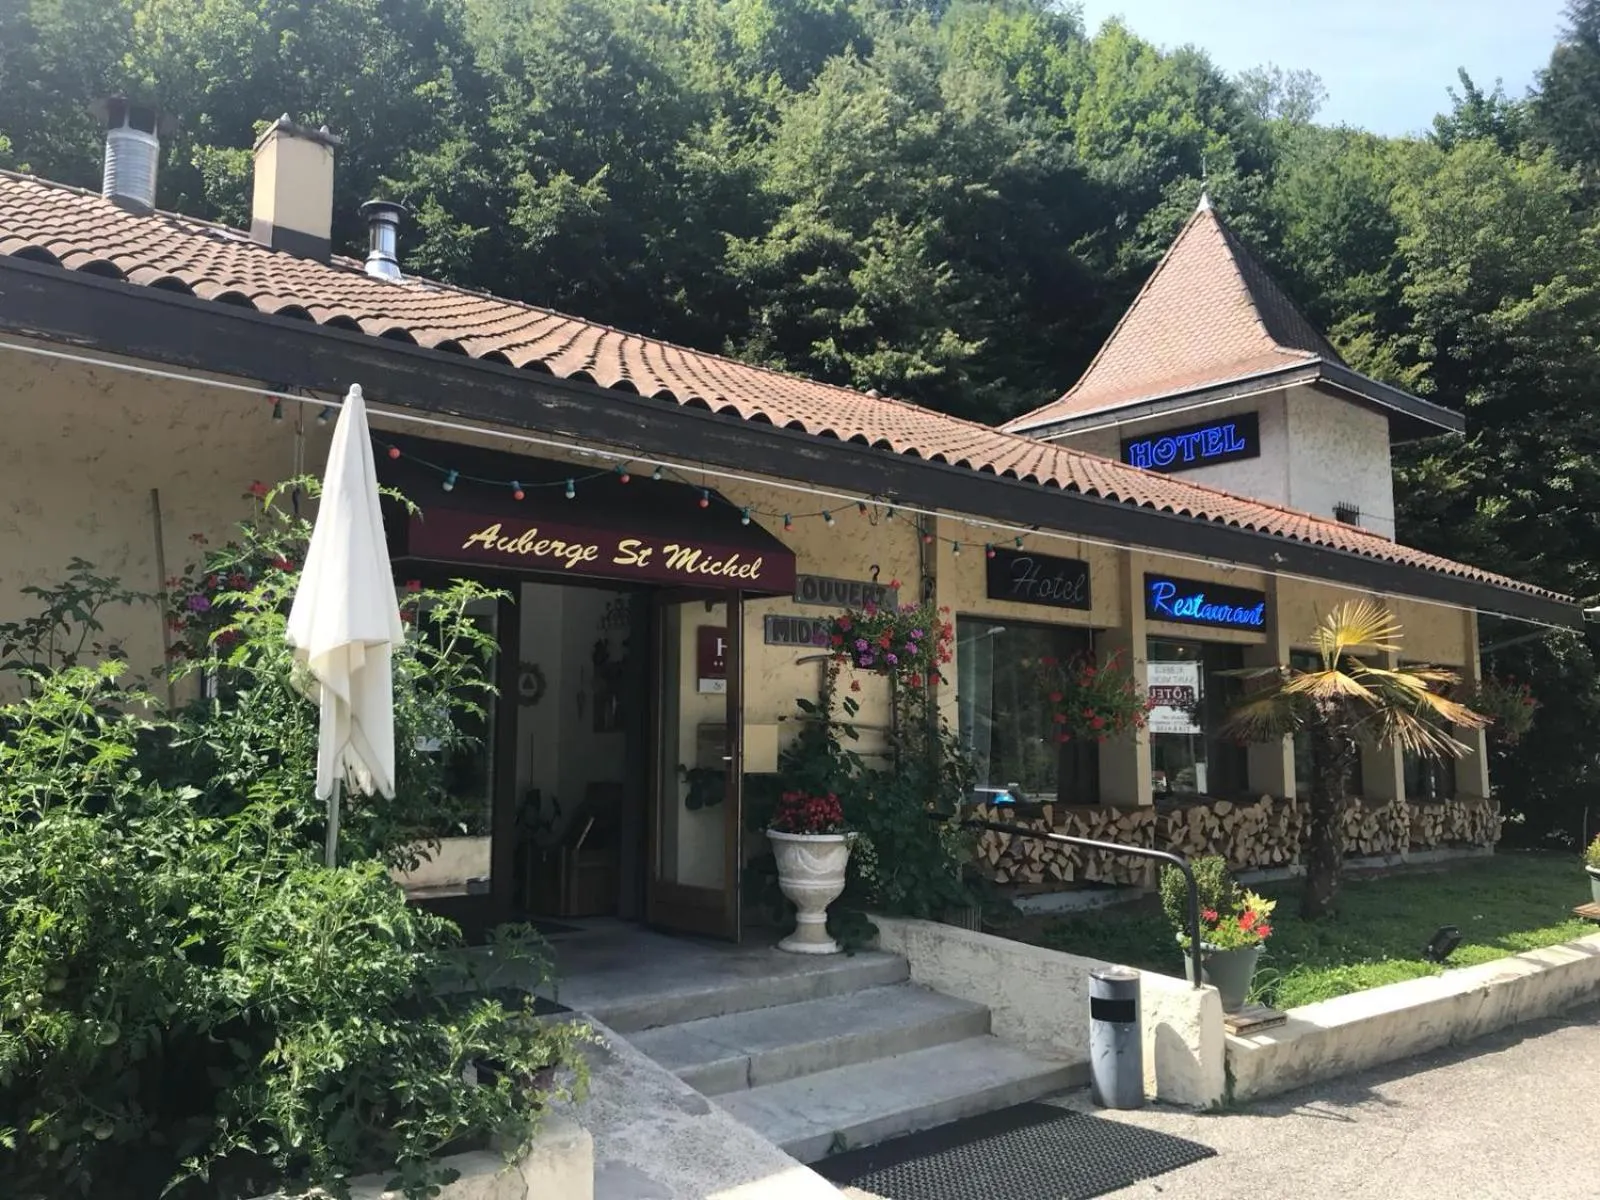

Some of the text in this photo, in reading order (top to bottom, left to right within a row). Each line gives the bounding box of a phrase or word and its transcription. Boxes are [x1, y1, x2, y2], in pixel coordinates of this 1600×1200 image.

[1129, 423, 1246, 469] HOTEL
[462, 523, 761, 580] Auberge St Michel
[1010, 557, 1085, 602] Hotel
[1151, 581, 1264, 626] Restaurant
